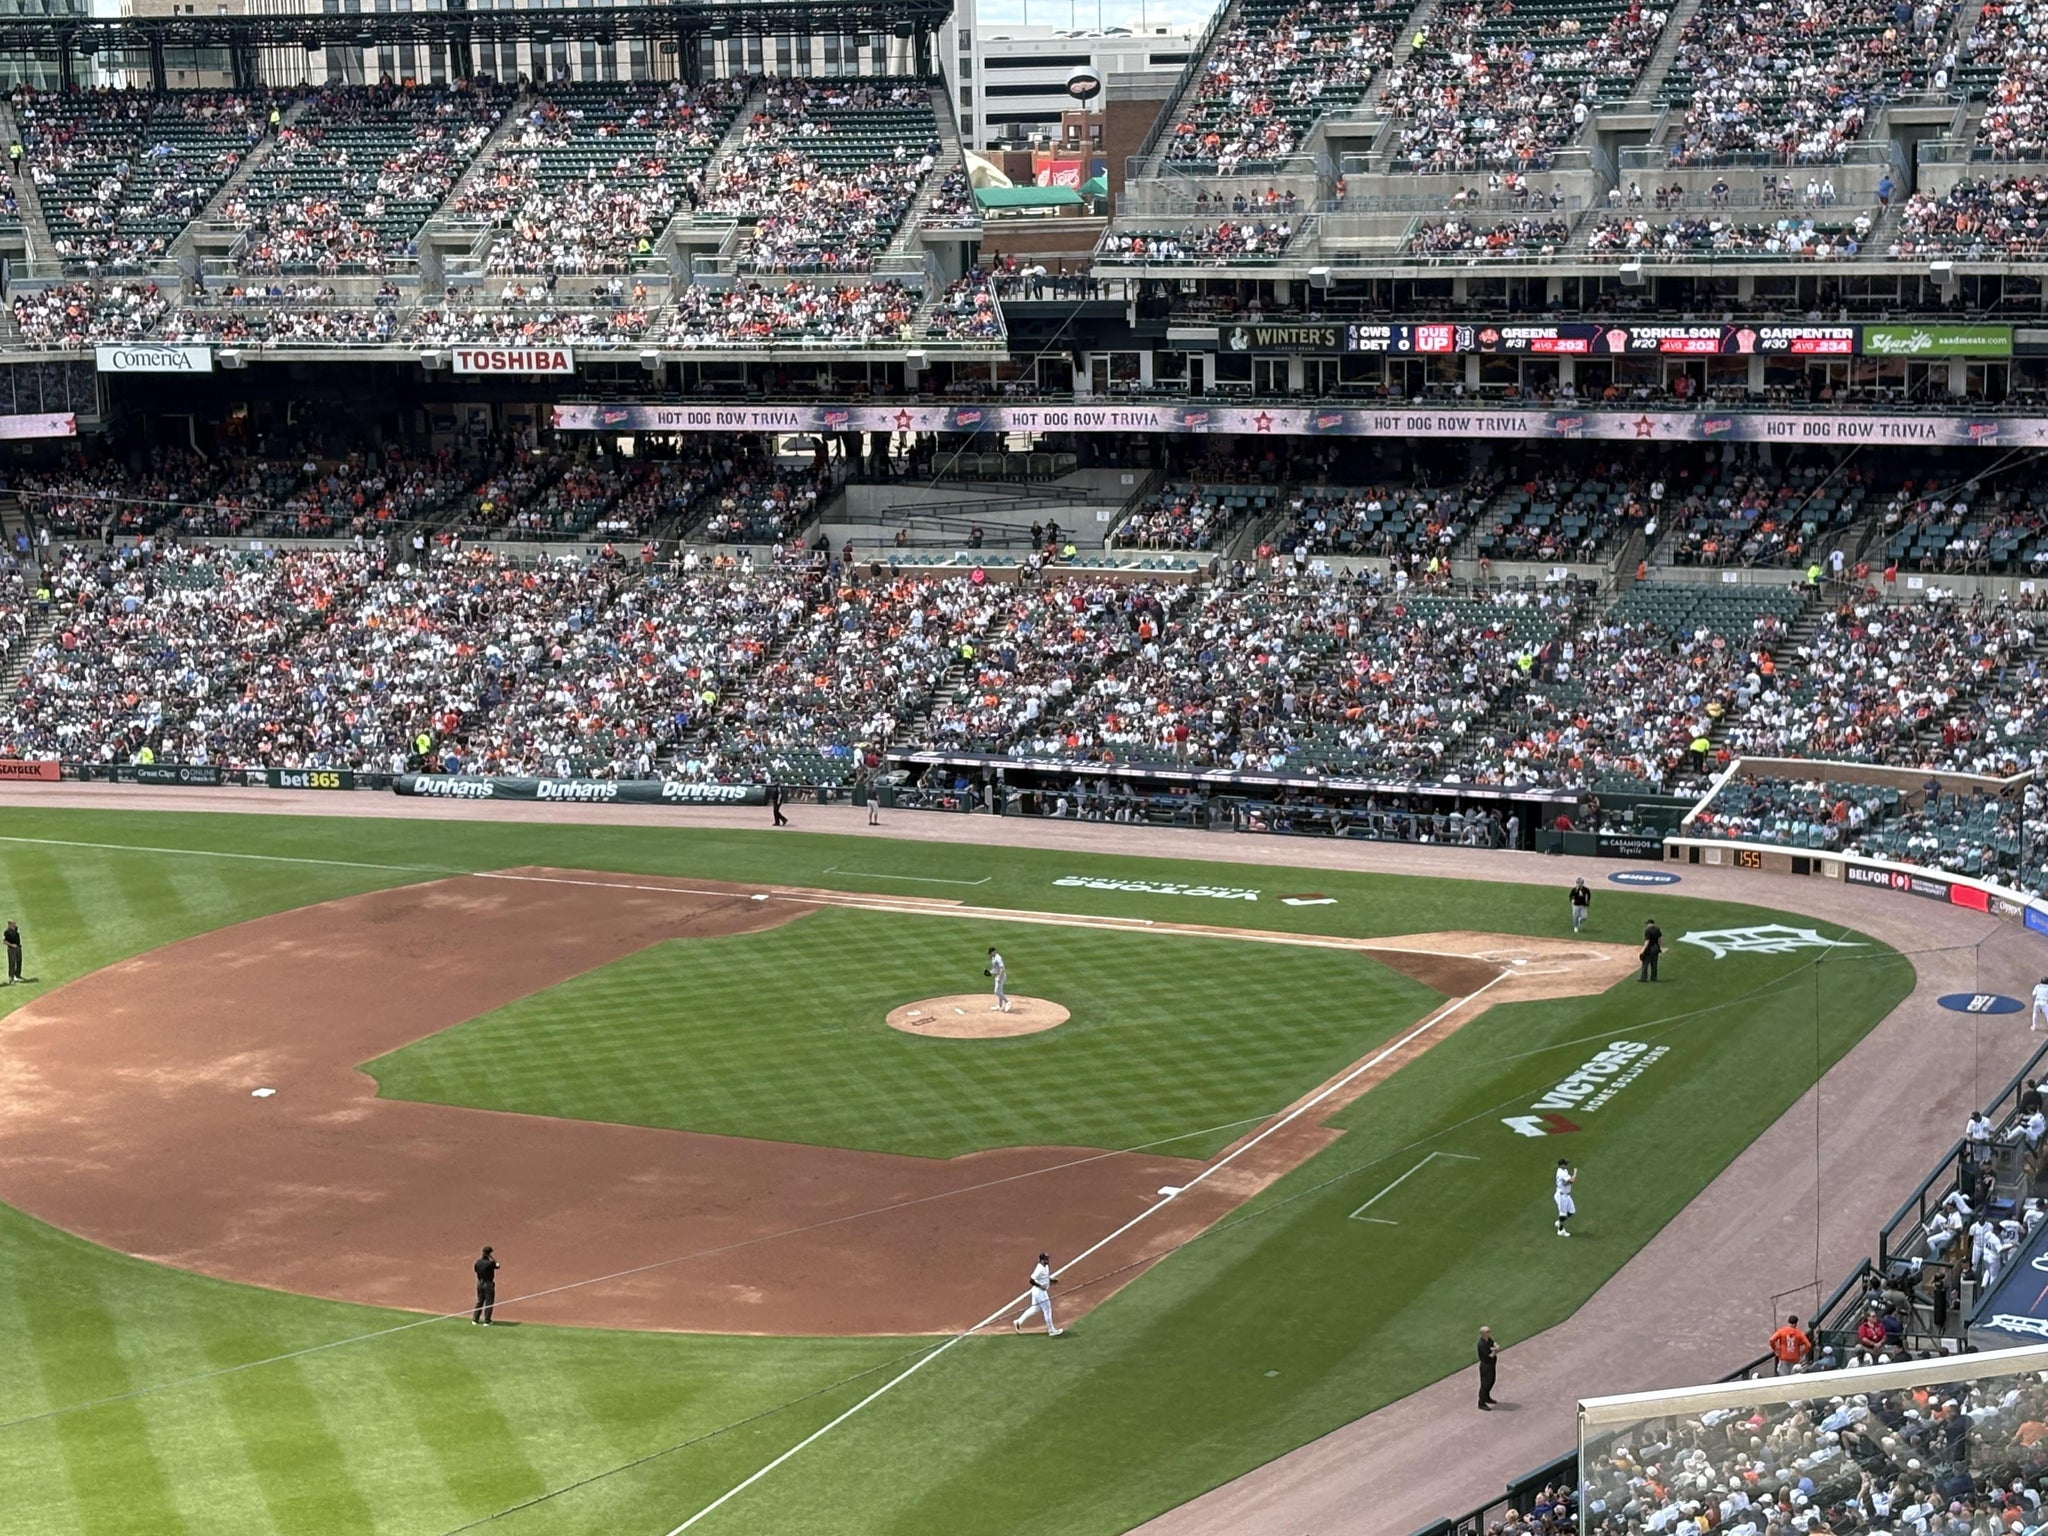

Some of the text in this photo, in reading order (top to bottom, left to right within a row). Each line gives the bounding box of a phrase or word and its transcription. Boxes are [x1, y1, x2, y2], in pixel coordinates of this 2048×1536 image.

[1255, 328, 1336, 347] WINTER'S
[1360, 326, 1408, 337] CWS 1
[1418, 327, 1449, 337] DUE
[1501, 328, 1558, 338] GREENE
[1630, 328, 1720, 338] TORKELSON
[1760, 328, 1853, 339] CARPENTER
[1360, 339, 1410, 350] DET 0
[1419, 338, 1449, 350] UP
[1505, 339, 1526, 348] #31
[1632, 339, 1657, 348] #20
[1762, 339, 1788, 349] #30
[1816, 341, 1847, 351] .234
[1938, 336, 2007, 345] saadmeats.com
[457, 351, 568, 370] TOSHIBA
[658, 412, 798, 425] HOT DOG ROW TRIVIA
[1012, 412, 1159, 426] HOT DOG ROW TRIVIA
[1374, 416, 1527, 431] HOT DOG ROW TRIVIA
[1767, 422, 1937, 438] HOT DOG ROW TRIVIA
[138, 769, 176, 779] Great Clips
[280, 771, 340, 787] bet365
[414, 776, 494, 796] Dunham's
[537, 780, 618, 798] Dunham's
[662, 781, 748, 799] Dunham's
[1610, 839, 1651, 848] CASAMIGOS
[1848, 868, 1890, 885] BELFOR
[1052, 879, 1258, 900] VICTORS
[1530, 1040, 1648, 1110] VICTORS
[1580, 1045, 1671, 1112] HOME SOLUTIONS
